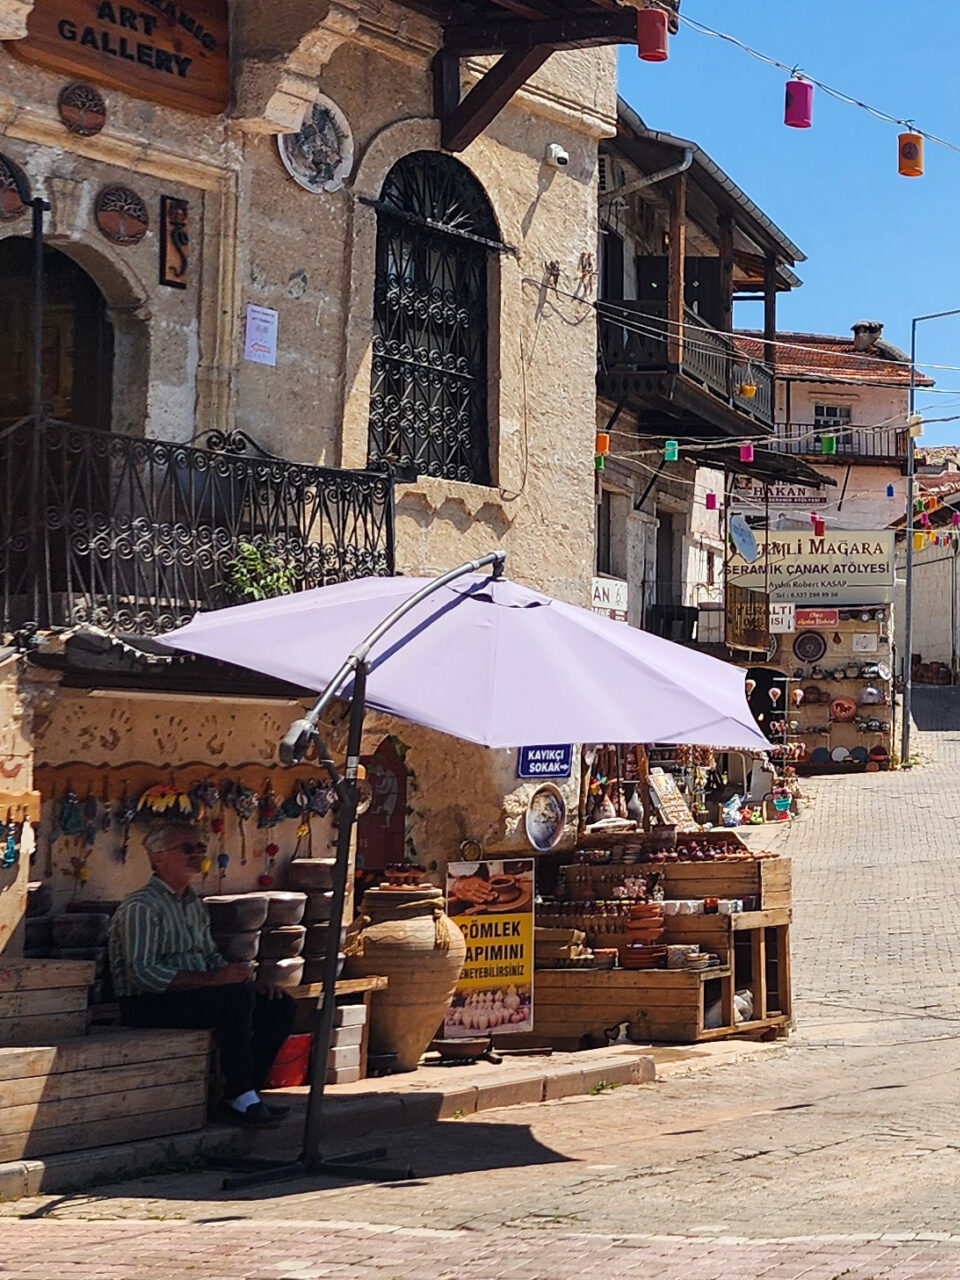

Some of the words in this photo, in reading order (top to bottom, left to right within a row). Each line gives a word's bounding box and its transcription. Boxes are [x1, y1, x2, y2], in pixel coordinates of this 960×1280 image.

[97, 0, 158, 37] ART
[57, 18, 193, 78] GALLERY
[808, 538, 884, 557] MAĞARA
[786, 563, 830, 577] ÇANAK
[833, 560, 890, 575] ATÖLYESİ
[820, 580, 848, 588] KASAP
[593, 584, 610, 604] AN
[527, 749, 565, 762] KAYIKÇI
[529, 761, 561, 773] SOKAK
[460, 919, 521, 939] ÇÖMLEK
[465, 943, 524, 962] APIMINI
[460, 962, 525, 980] ENEYEBİLİRSİNİZ
